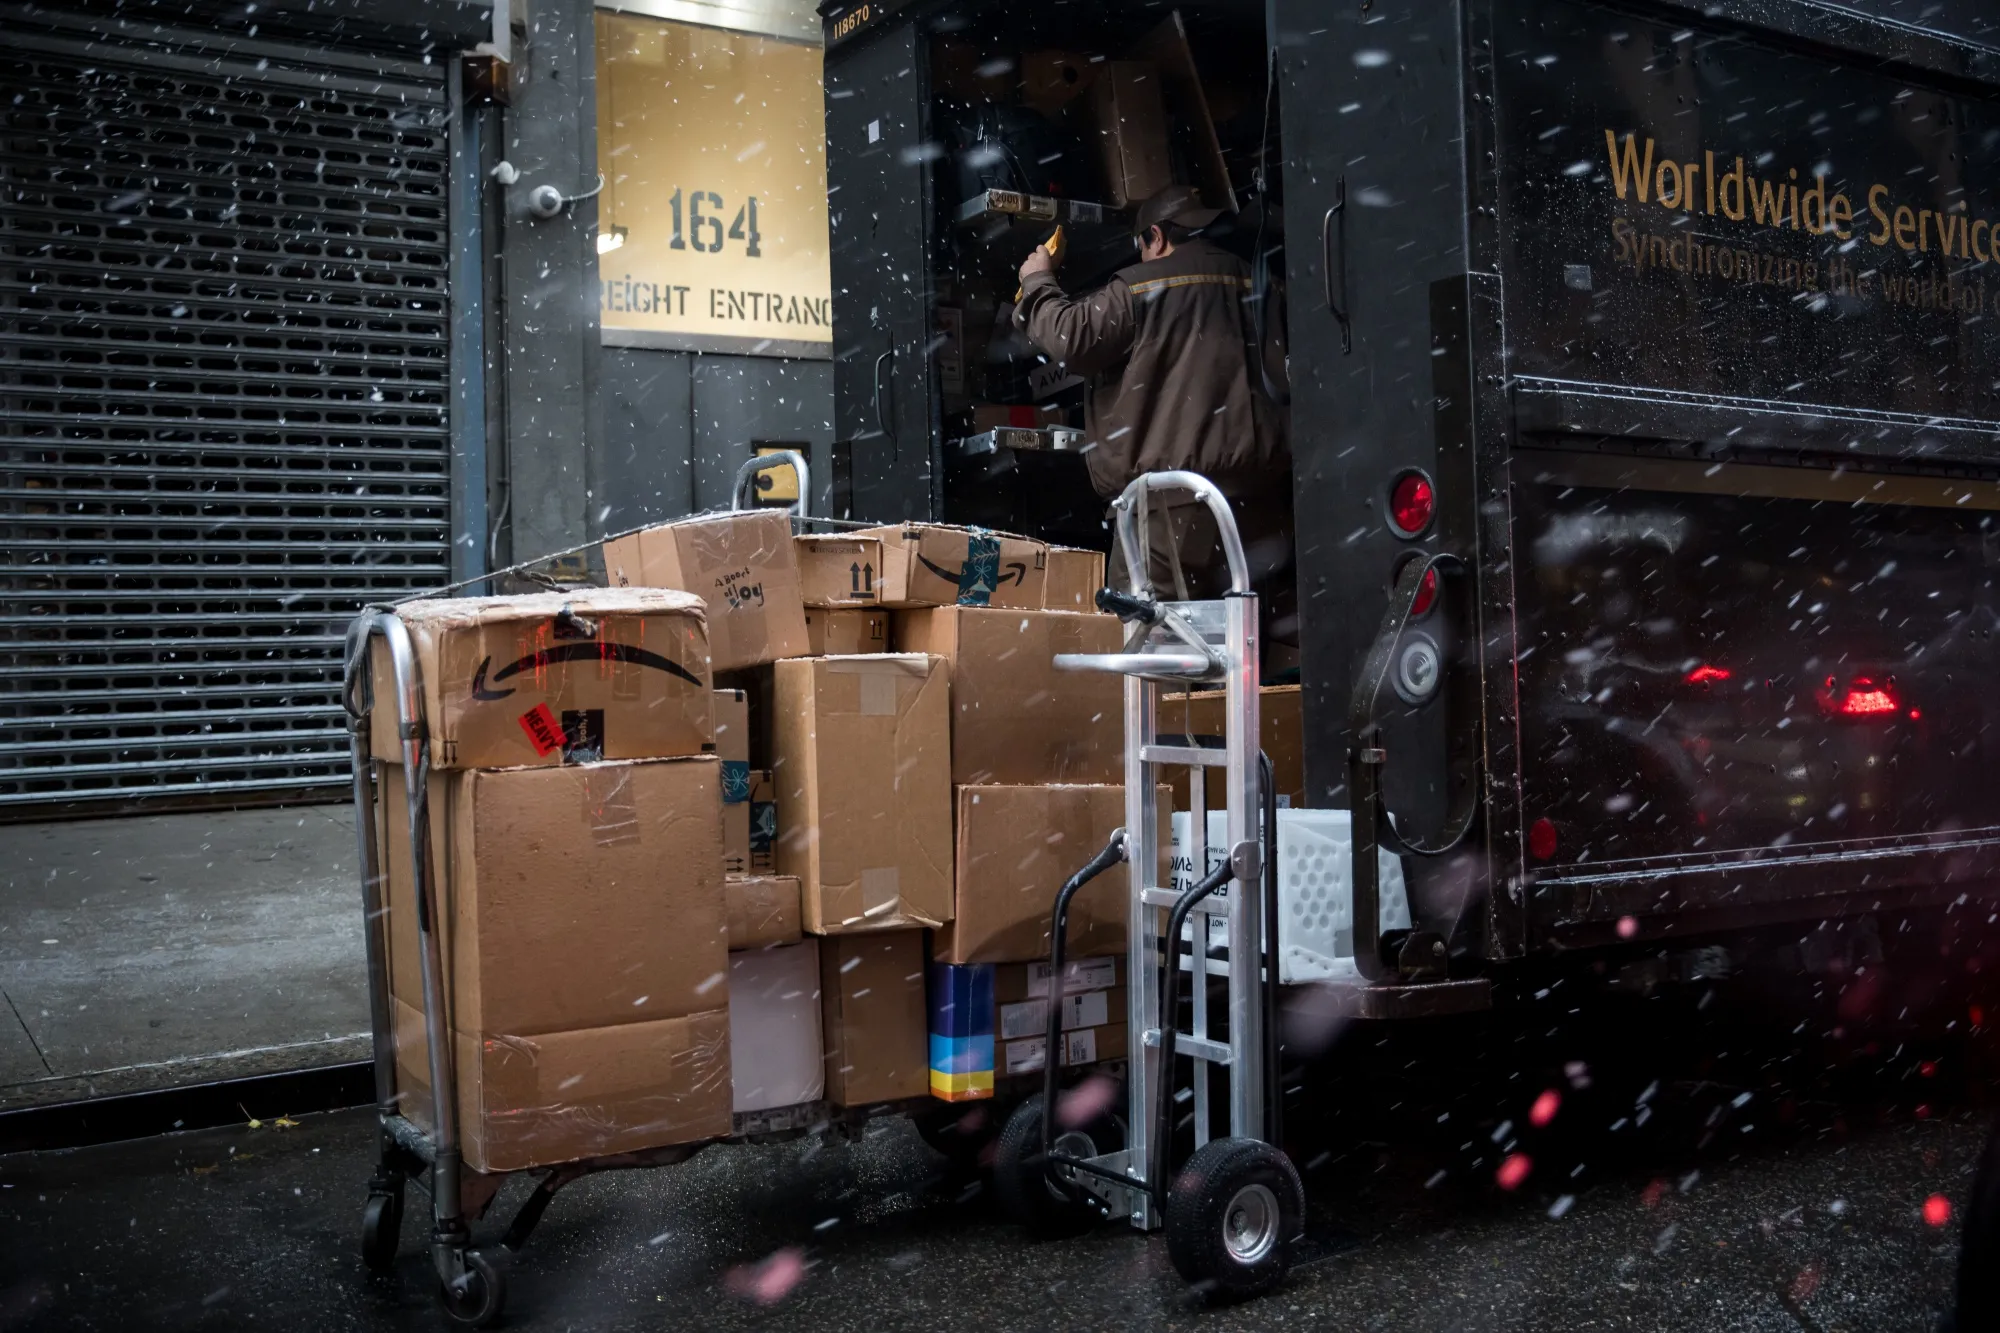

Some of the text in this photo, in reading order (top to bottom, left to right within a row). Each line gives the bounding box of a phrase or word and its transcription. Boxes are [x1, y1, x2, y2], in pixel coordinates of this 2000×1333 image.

[834, 4, 870, 40] 118670
[1605, 129, 1853, 239] Worldwide
[669, 187, 761, 257] 164
[1612, 217, 1819, 291] Synchronizing
[524, 708, 559, 751] HEAVY
